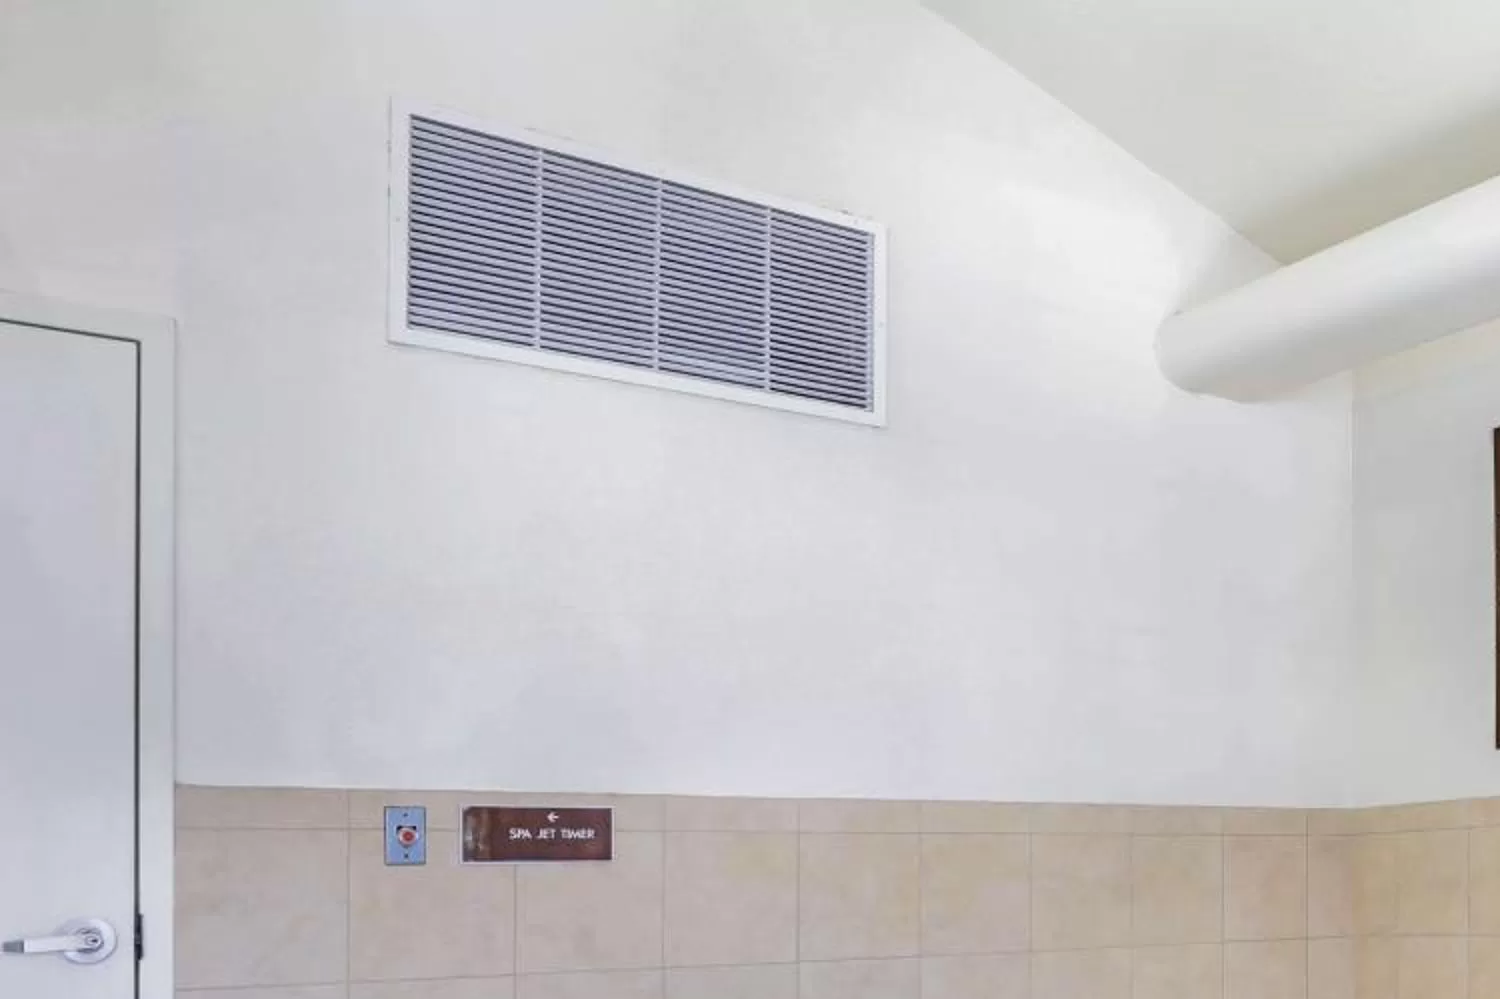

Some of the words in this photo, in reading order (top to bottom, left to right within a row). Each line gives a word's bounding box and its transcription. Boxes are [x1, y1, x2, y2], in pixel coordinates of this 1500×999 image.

[508, 827, 532, 840] SPA
[535, 827, 556, 840] JET
[560, 827, 596, 840] TIMER
